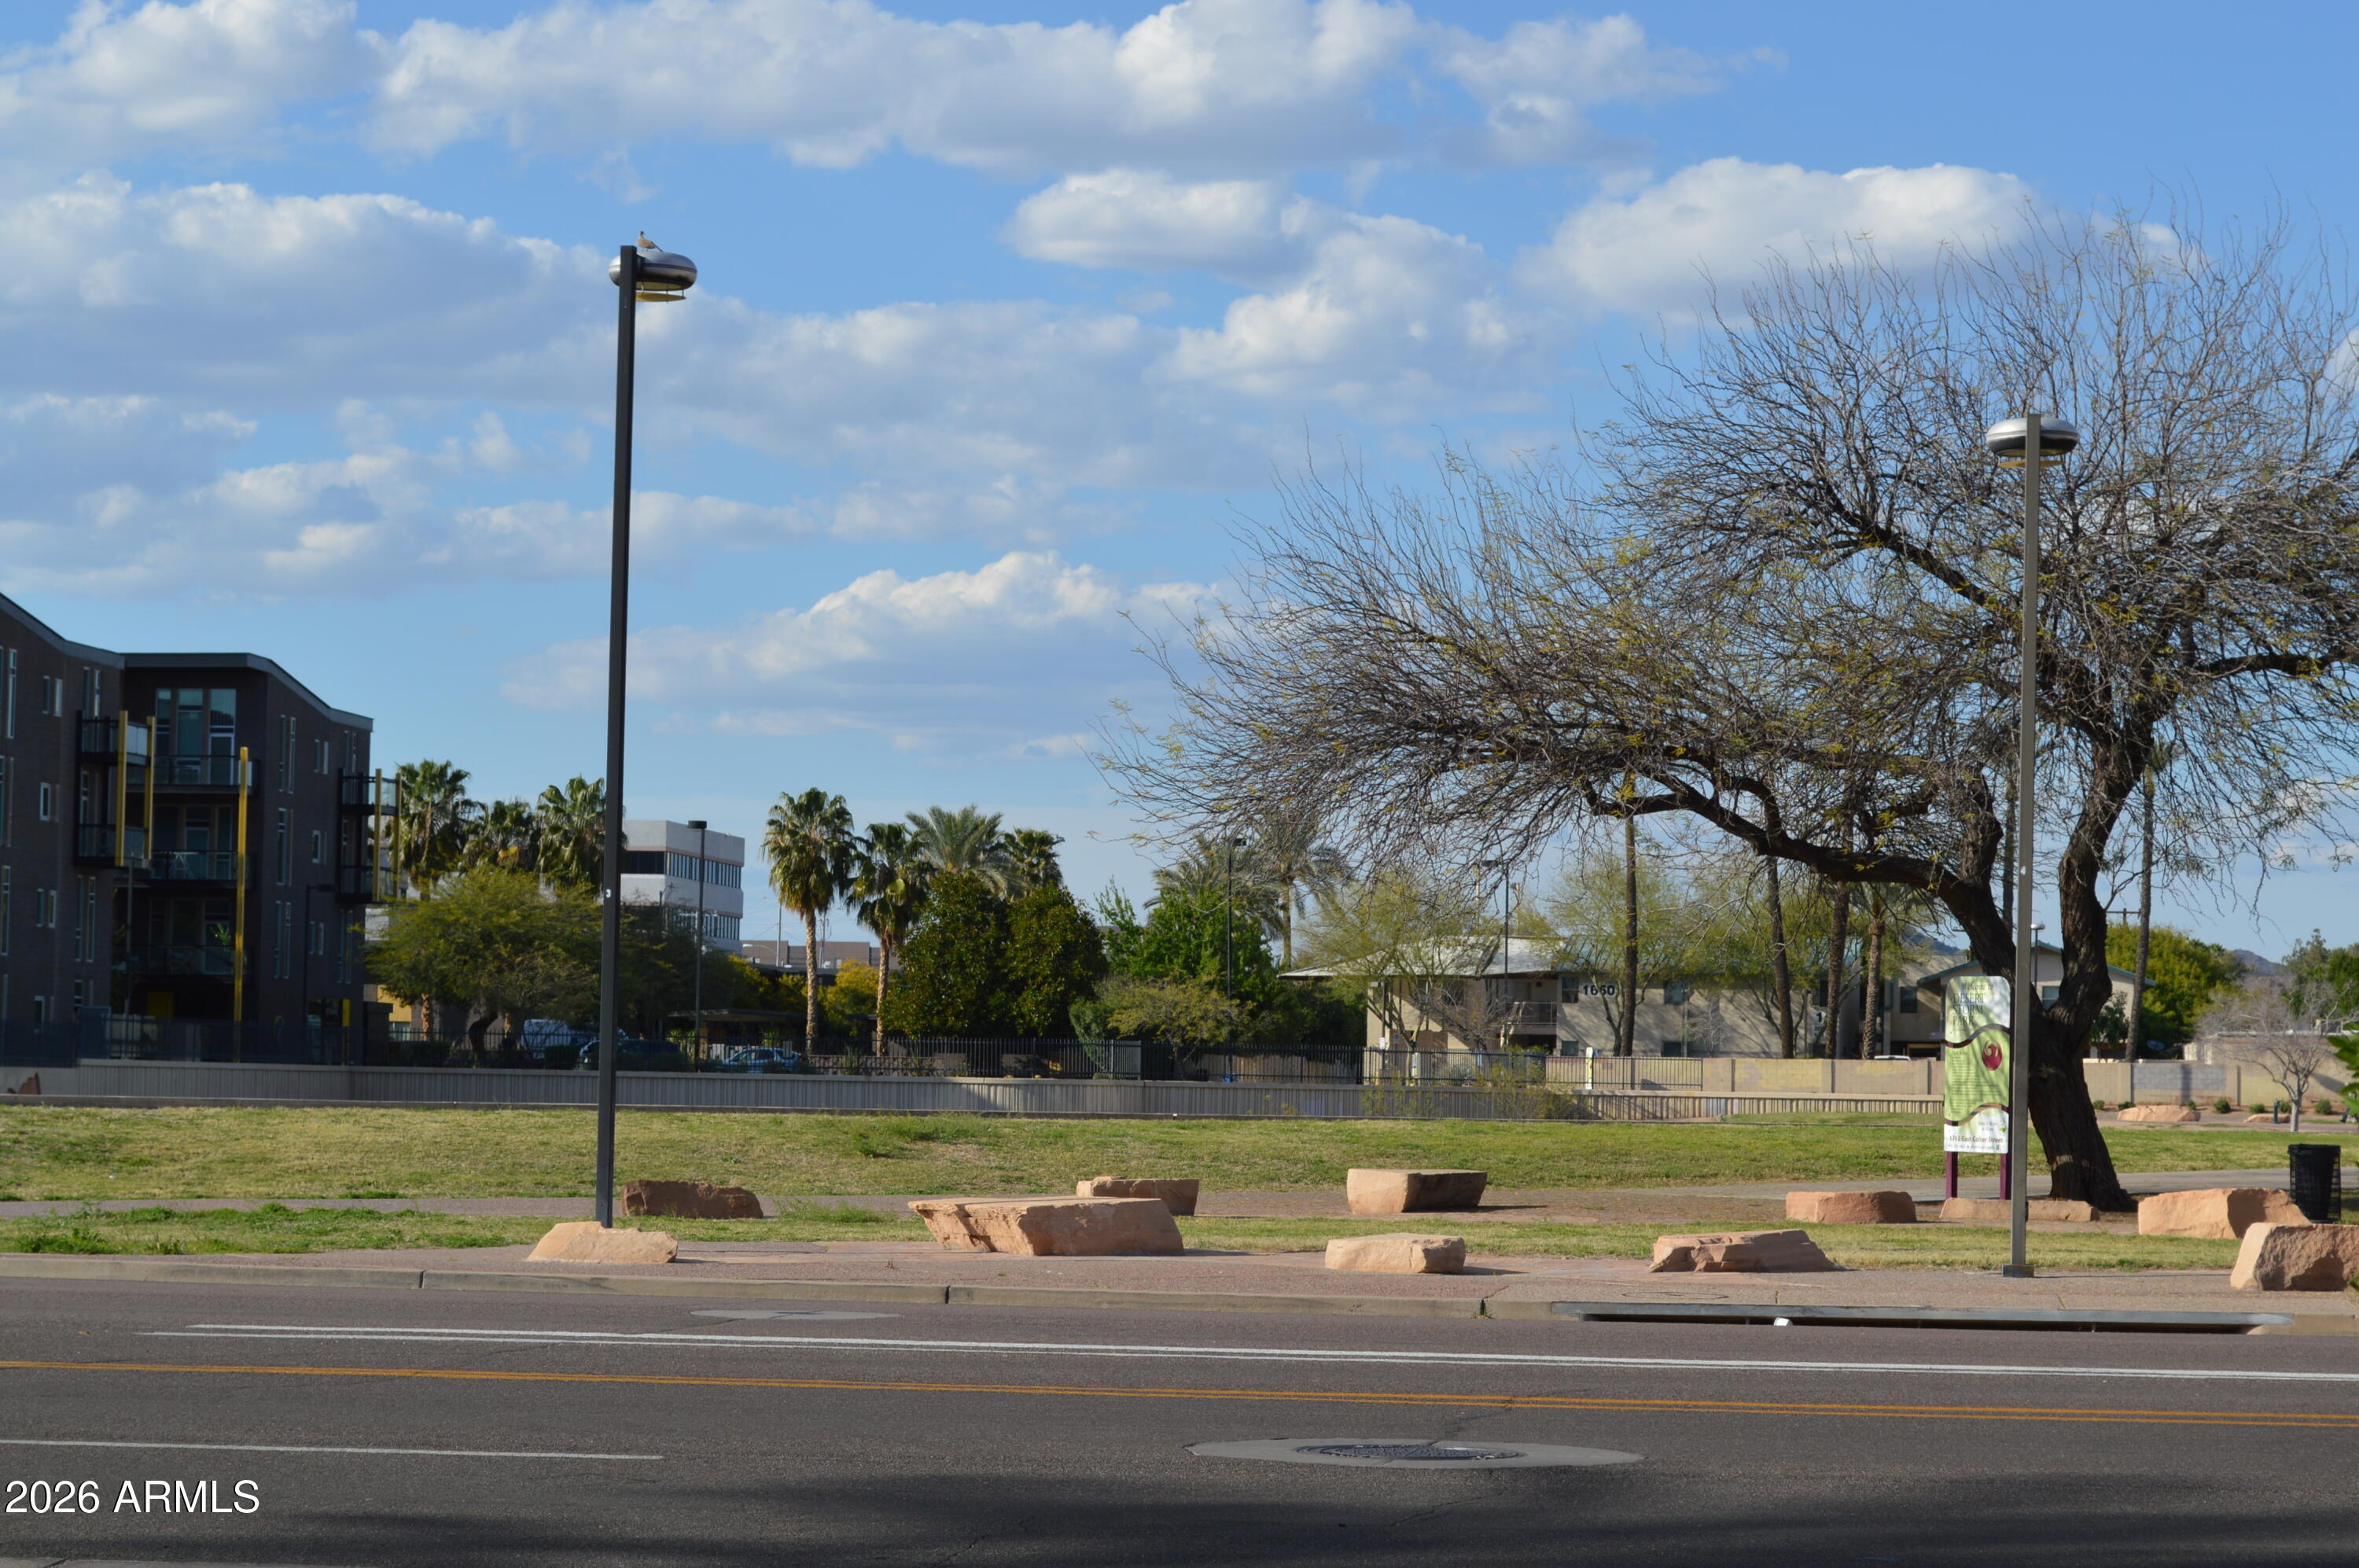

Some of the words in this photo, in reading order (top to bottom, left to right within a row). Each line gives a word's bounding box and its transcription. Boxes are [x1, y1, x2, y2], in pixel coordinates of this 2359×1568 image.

[605, 889, 611, 897] 3
[1953, 993, 1985, 1003] DESERT
[1952, 1004, 1984, 1014] STORM
[1952, 1015, 1975, 1025] PARK
